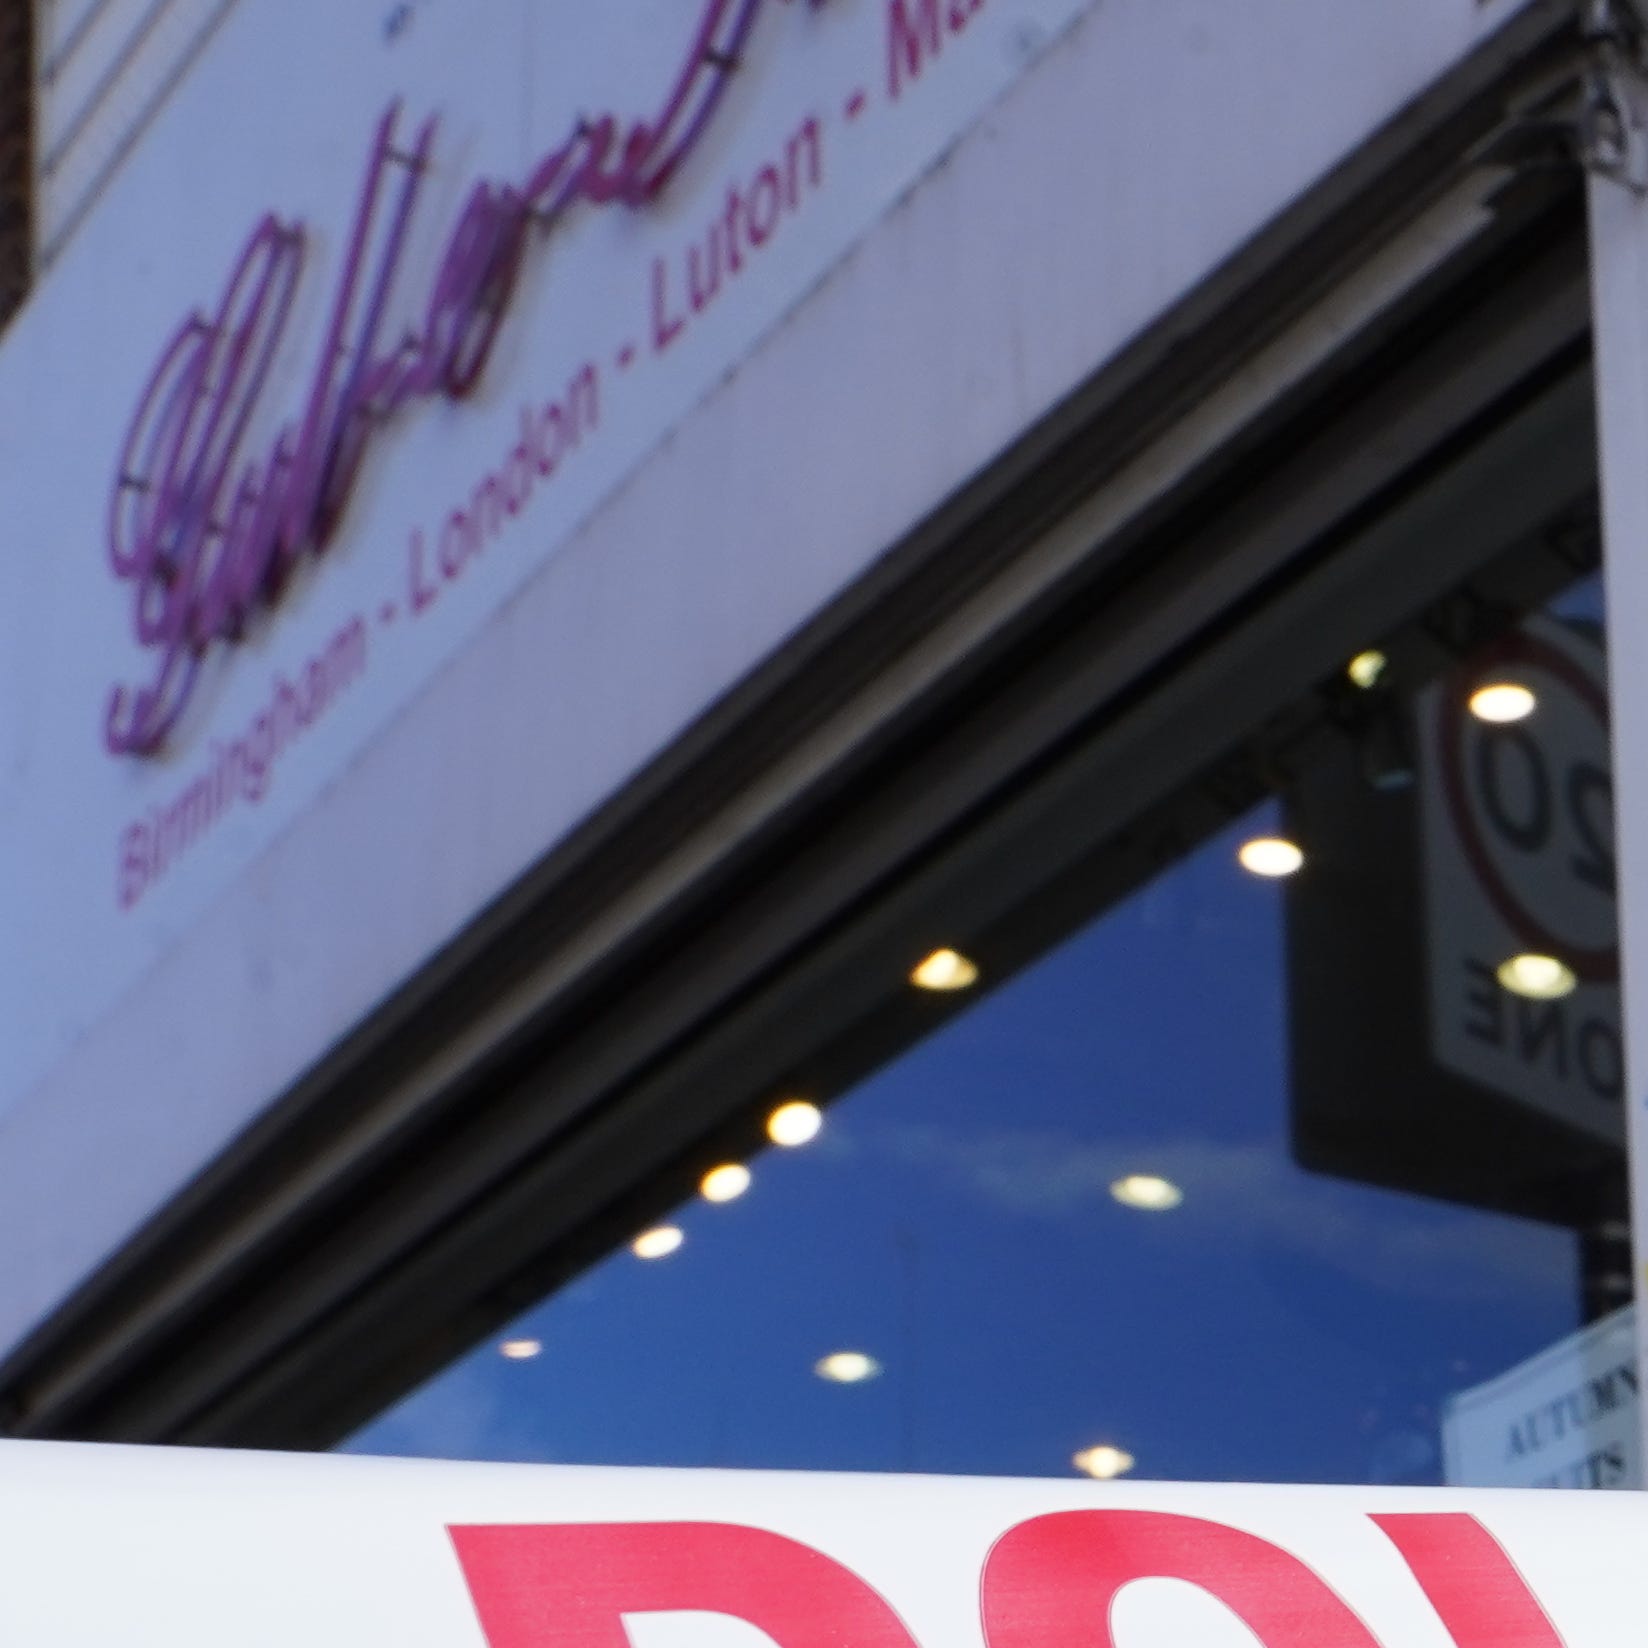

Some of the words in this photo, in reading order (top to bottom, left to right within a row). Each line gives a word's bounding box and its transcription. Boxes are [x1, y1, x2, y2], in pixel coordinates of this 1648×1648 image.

[117, 612, 366, 910] Birmingham
[406, 362, 597, 616] London
[650, 116, 821, 352] Luton
